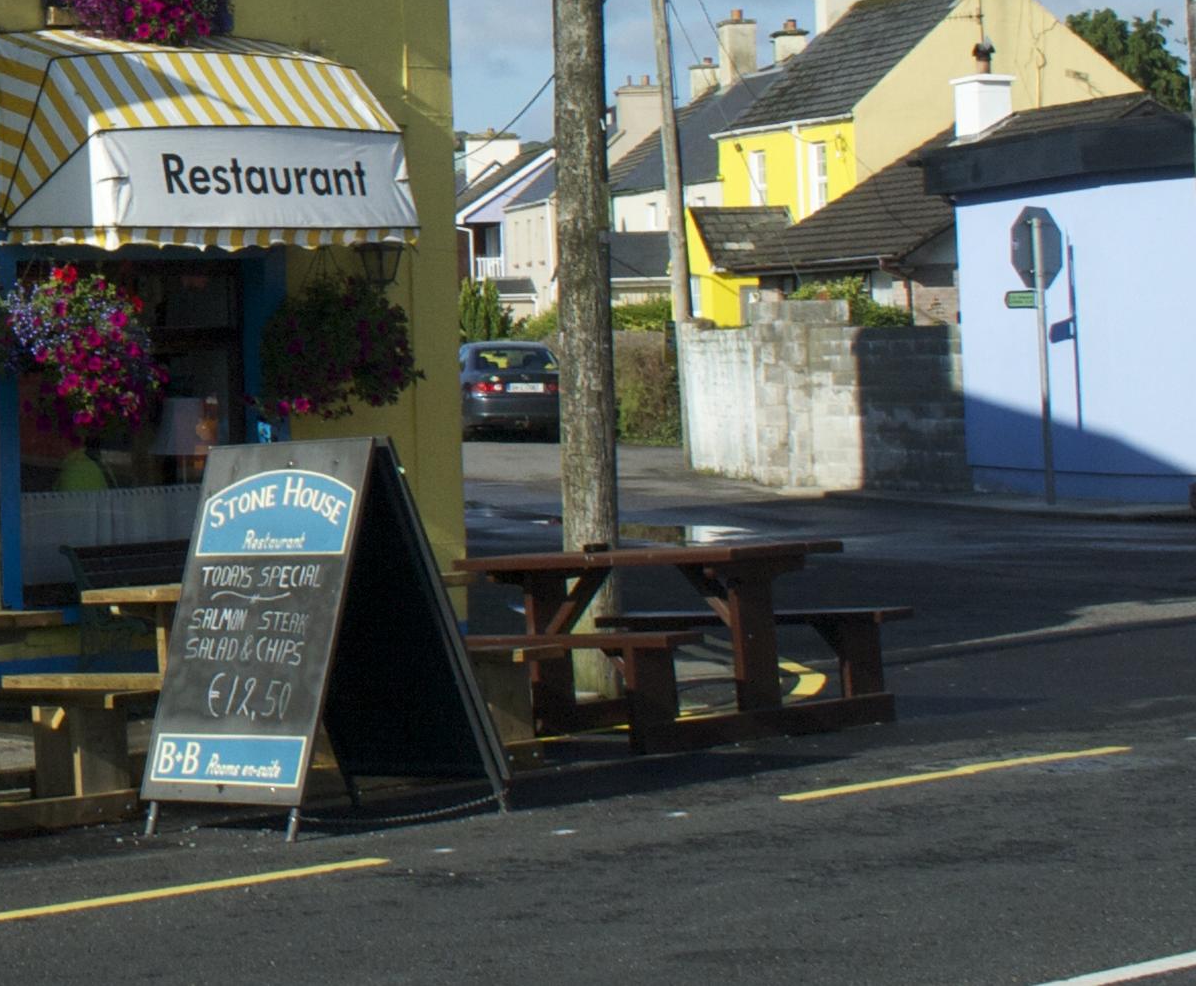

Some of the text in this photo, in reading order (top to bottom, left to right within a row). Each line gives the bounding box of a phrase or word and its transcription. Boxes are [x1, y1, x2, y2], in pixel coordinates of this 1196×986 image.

[161, 153, 367, 197] Restaurant
[209, 476, 347, 528] STONE HOUSE
[241, 529, 306, 550] Restaurant
[202, 564, 322, 589] TODAYS SPECIAL
[188, 607, 309, 634] SALMON STEAK
[184, 634, 305, 666] SALAD & CHIPS
[205, 752, 241, 775] Rooms
